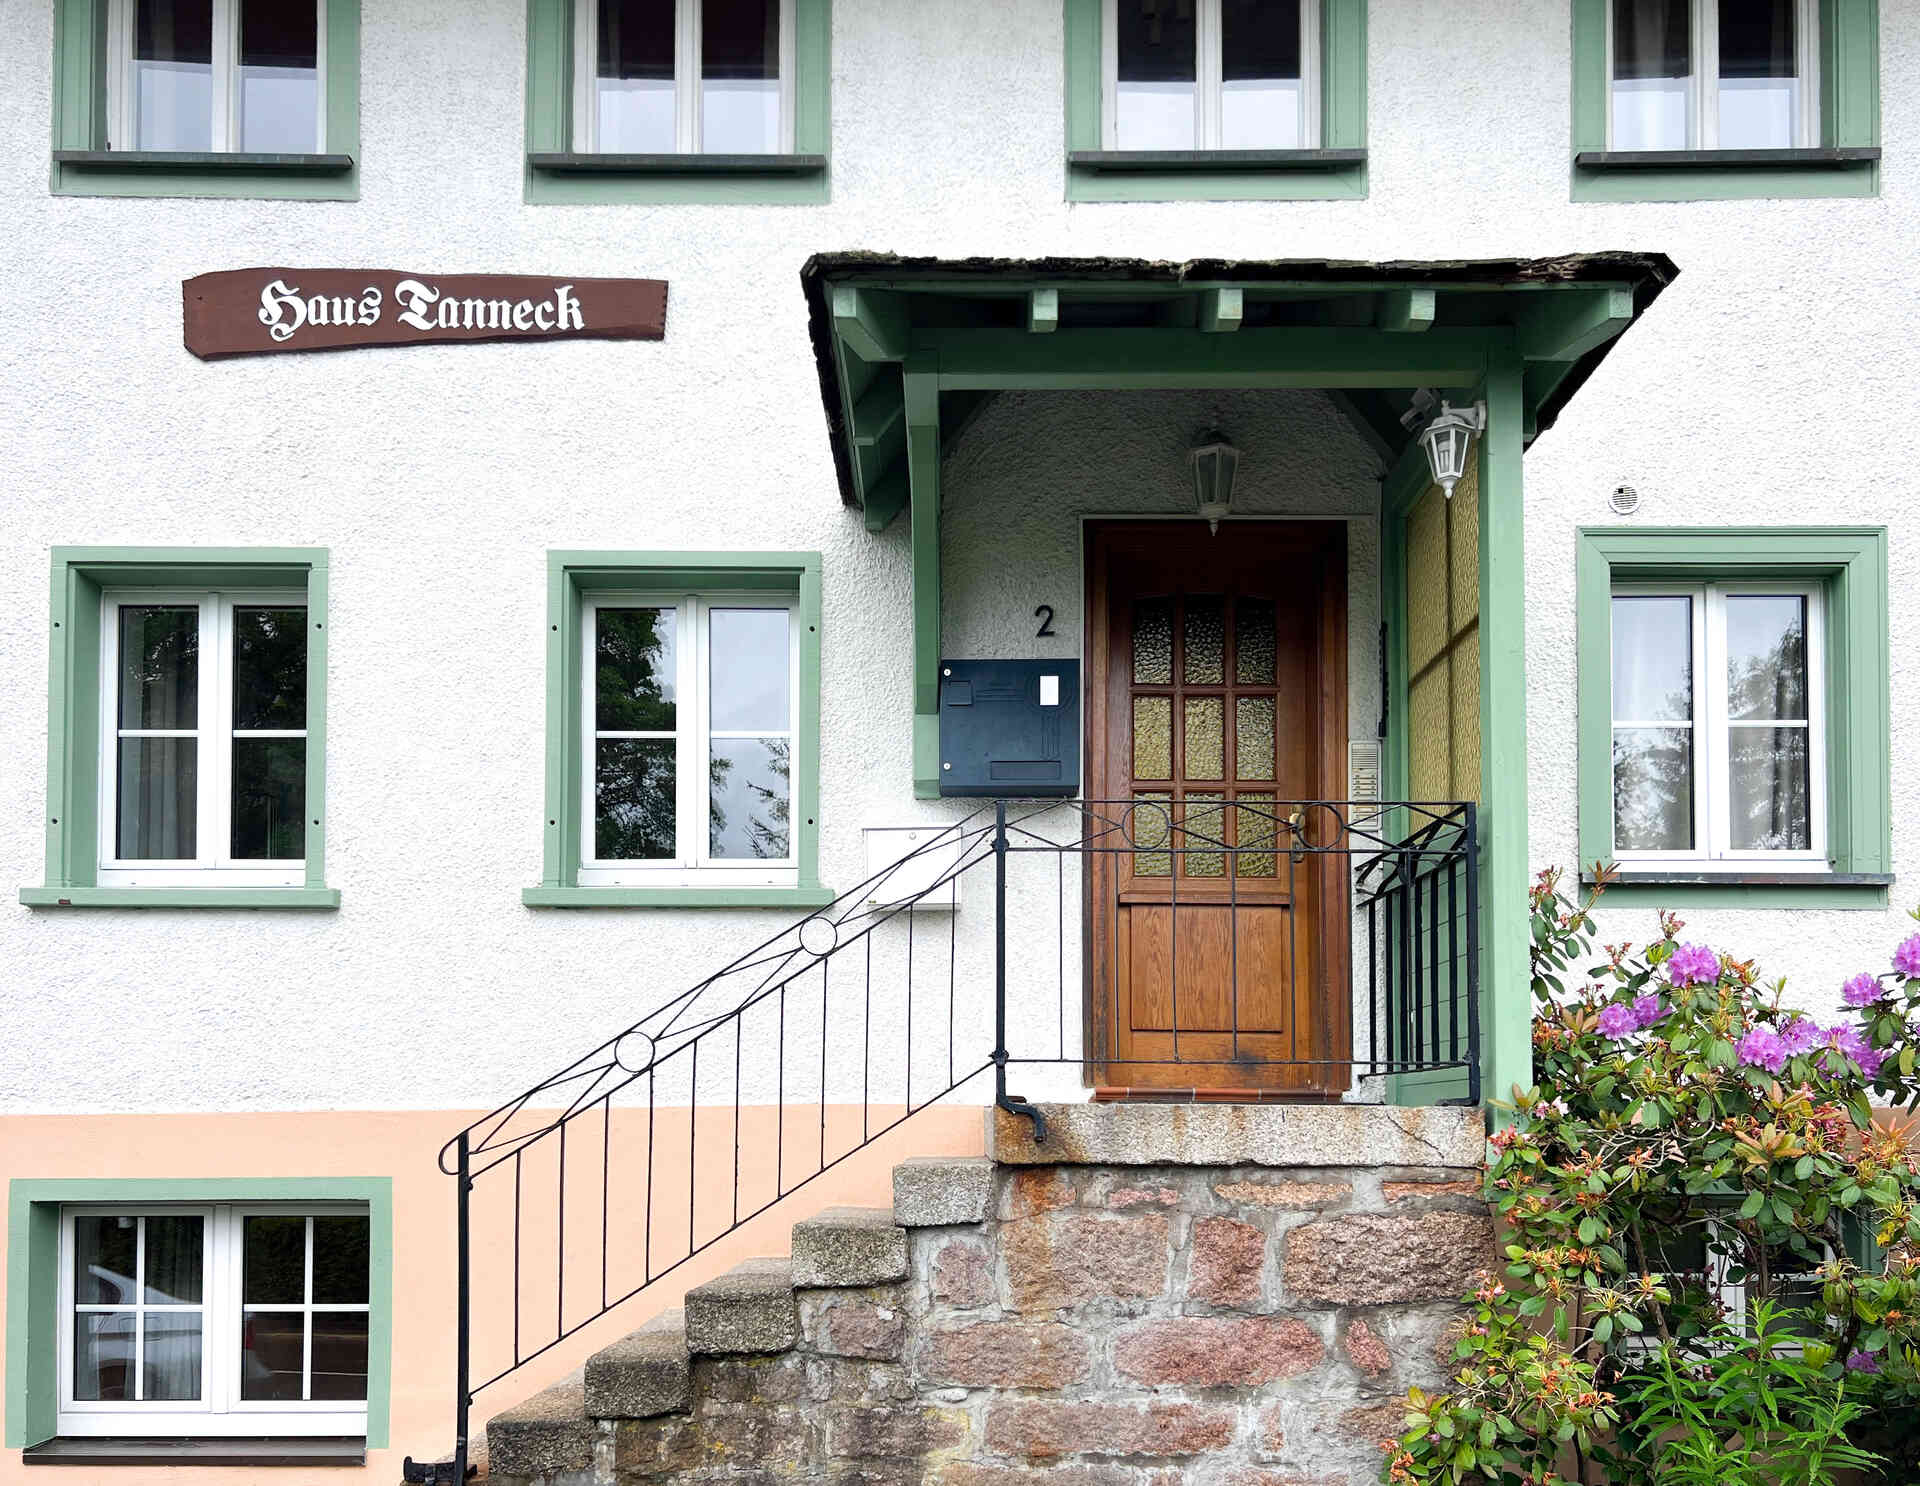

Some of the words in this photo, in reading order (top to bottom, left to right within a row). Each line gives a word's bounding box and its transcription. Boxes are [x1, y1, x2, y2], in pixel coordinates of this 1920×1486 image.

[258, 280, 382, 342] Haus
[395, 279, 585, 331] Tanneck
[1035, 605, 1055, 638] 2
